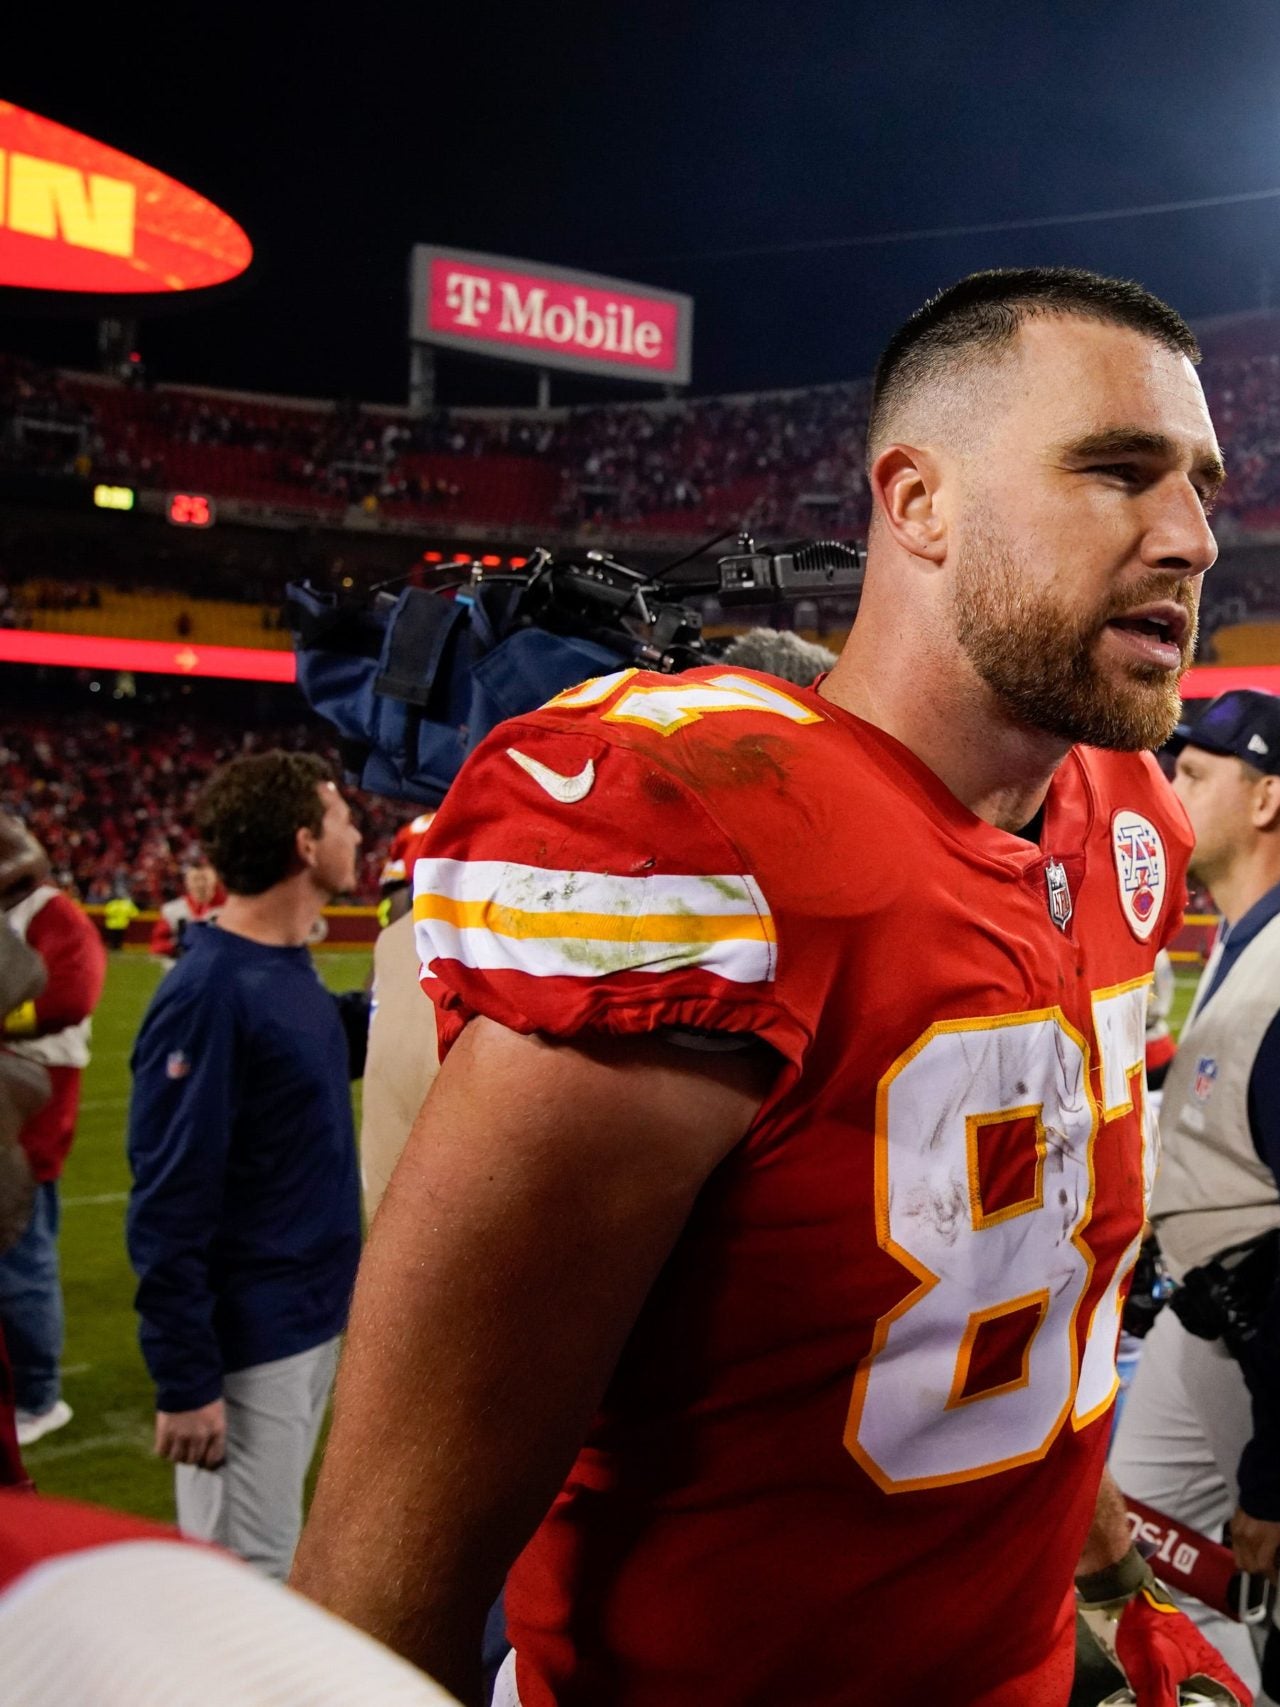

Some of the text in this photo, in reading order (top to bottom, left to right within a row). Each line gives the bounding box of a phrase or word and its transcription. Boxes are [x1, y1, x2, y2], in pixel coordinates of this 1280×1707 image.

[0, 147, 136, 259] N
[498, 281, 663, 359] Mobile
[842, 972, 1163, 1495] 87
